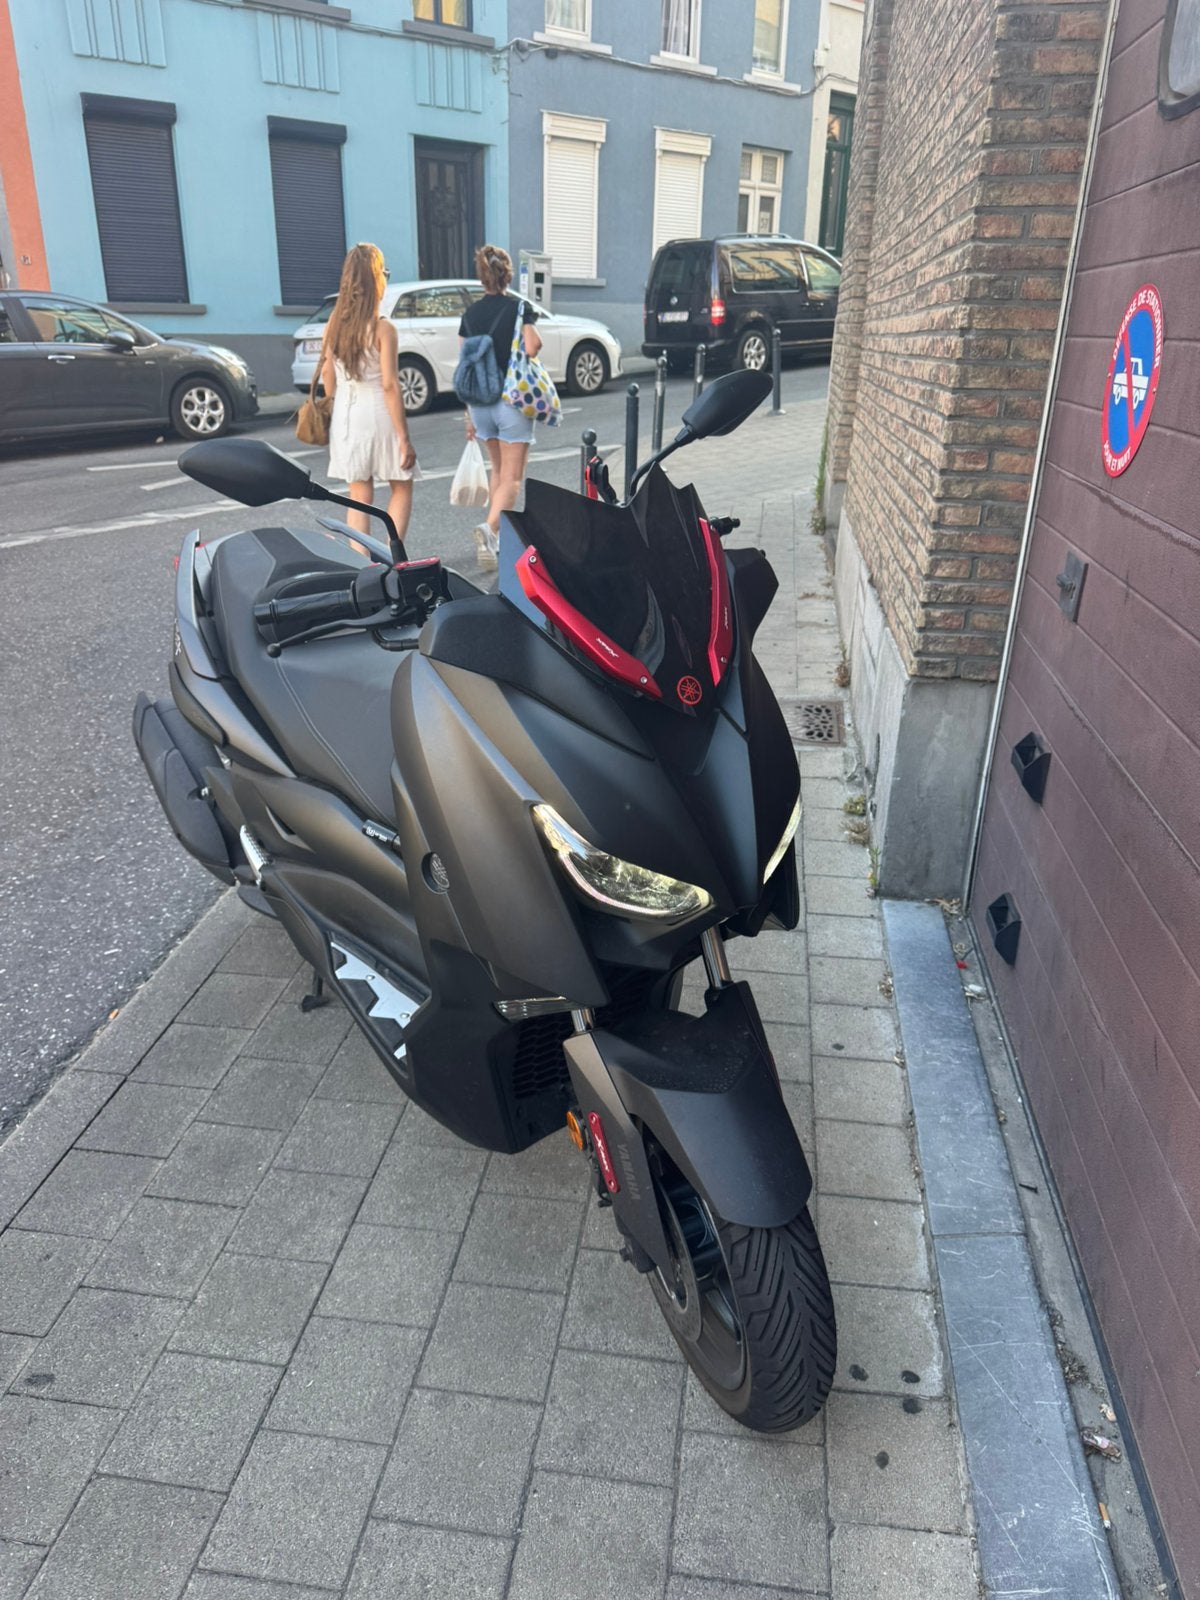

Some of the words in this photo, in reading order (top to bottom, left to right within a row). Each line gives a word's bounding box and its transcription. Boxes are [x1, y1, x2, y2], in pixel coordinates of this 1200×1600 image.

[1138, 290, 1147, 306] DE
[1146, 290, 1162, 369] STATIONNER
[617, 1144, 641, 1200] YAMAHA
